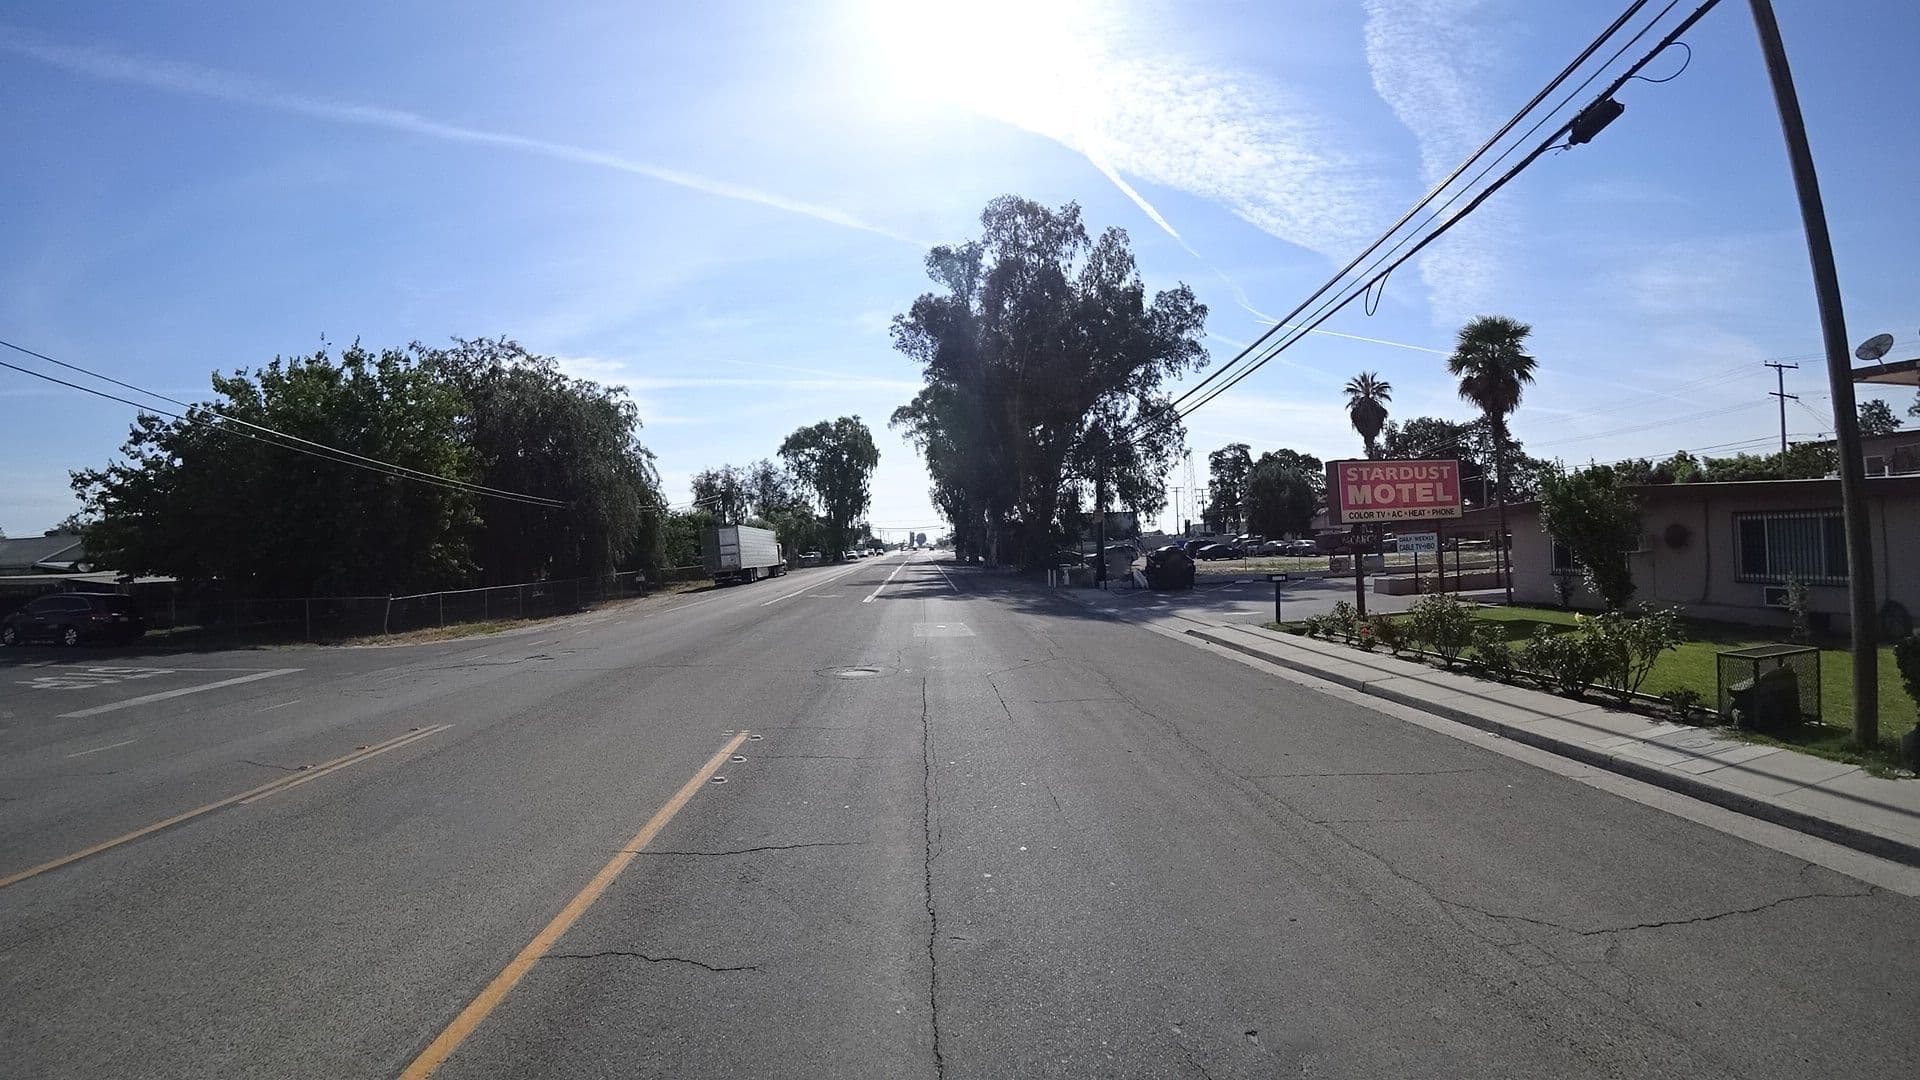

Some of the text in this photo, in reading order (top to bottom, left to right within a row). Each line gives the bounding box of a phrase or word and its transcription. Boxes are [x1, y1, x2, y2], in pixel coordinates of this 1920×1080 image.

[1346, 466, 1450, 481] STARDUST
[1347, 482, 1453, 505] MOTEL
[1348, 511, 1374, 520] COLOR
[1408, 509, 1426, 517] HEAT
[1431, 508, 1455, 516] PHONE
